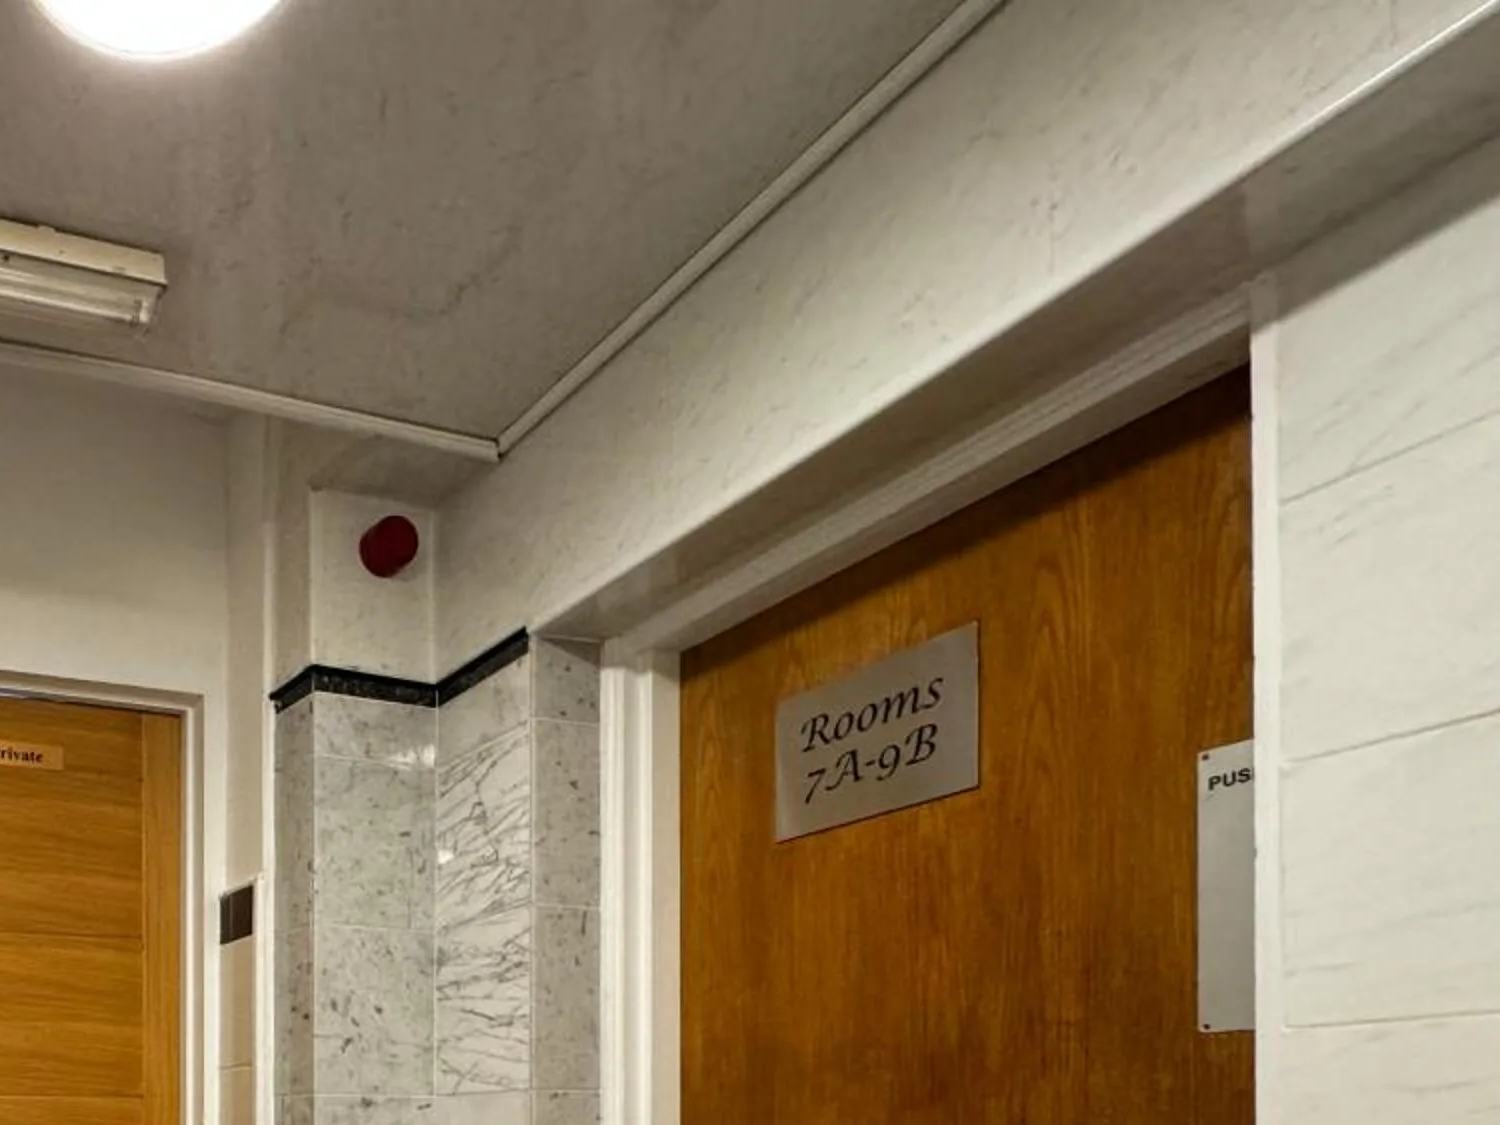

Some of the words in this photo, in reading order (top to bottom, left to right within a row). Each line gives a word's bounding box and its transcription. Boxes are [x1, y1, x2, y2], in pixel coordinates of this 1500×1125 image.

[801, 677, 943, 752] Rooms
[804, 723, 938, 804] 7A-9B
[1208, 767, 1254, 791] PUS
